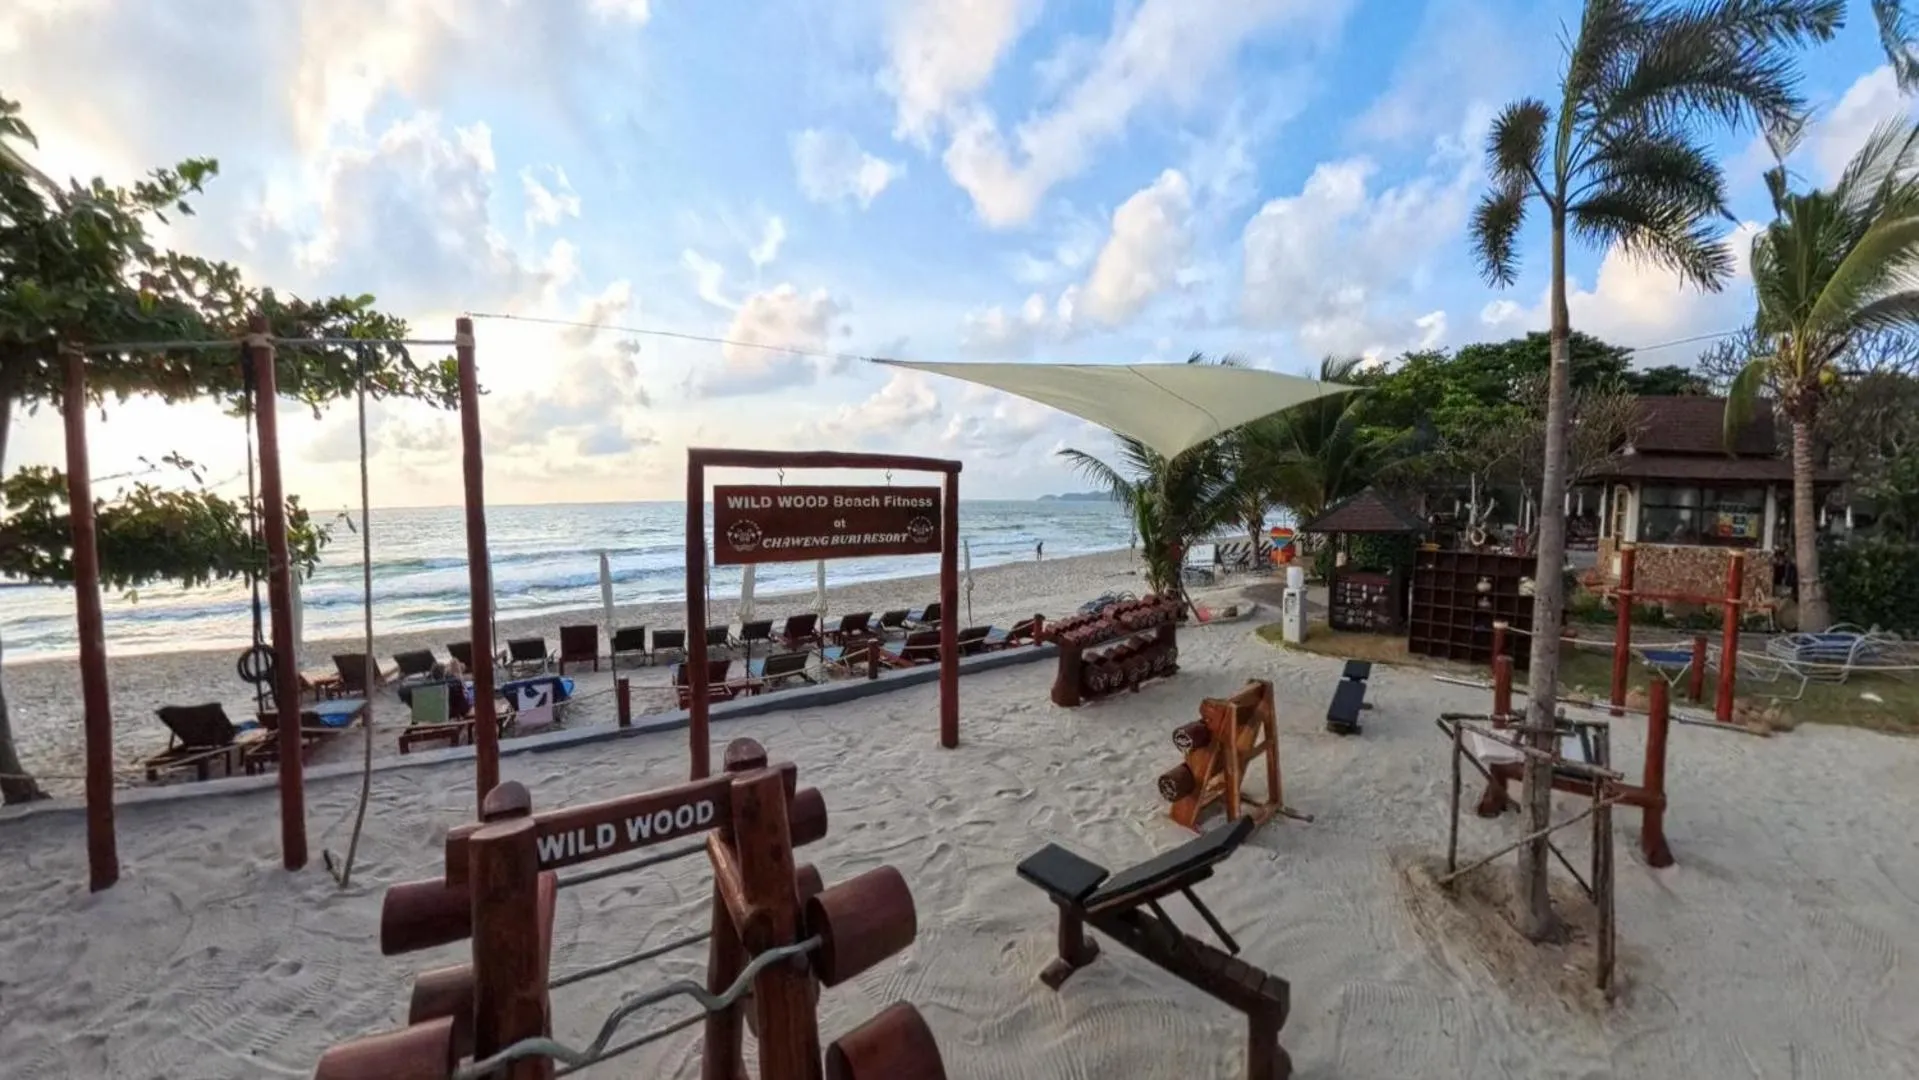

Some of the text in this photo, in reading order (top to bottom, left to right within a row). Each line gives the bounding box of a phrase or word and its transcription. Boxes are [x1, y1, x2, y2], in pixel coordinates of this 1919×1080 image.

[727, 495, 933, 509] WILD WOOD Beach Fitness
[833, 518, 846, 528] at
[762, 535, 829, 549] CHAWENG
[831, 534, 861, 546] BURI
[863, 532, 908, 545] RESORT
[537, 800, 714, 862] WILD WOOD
